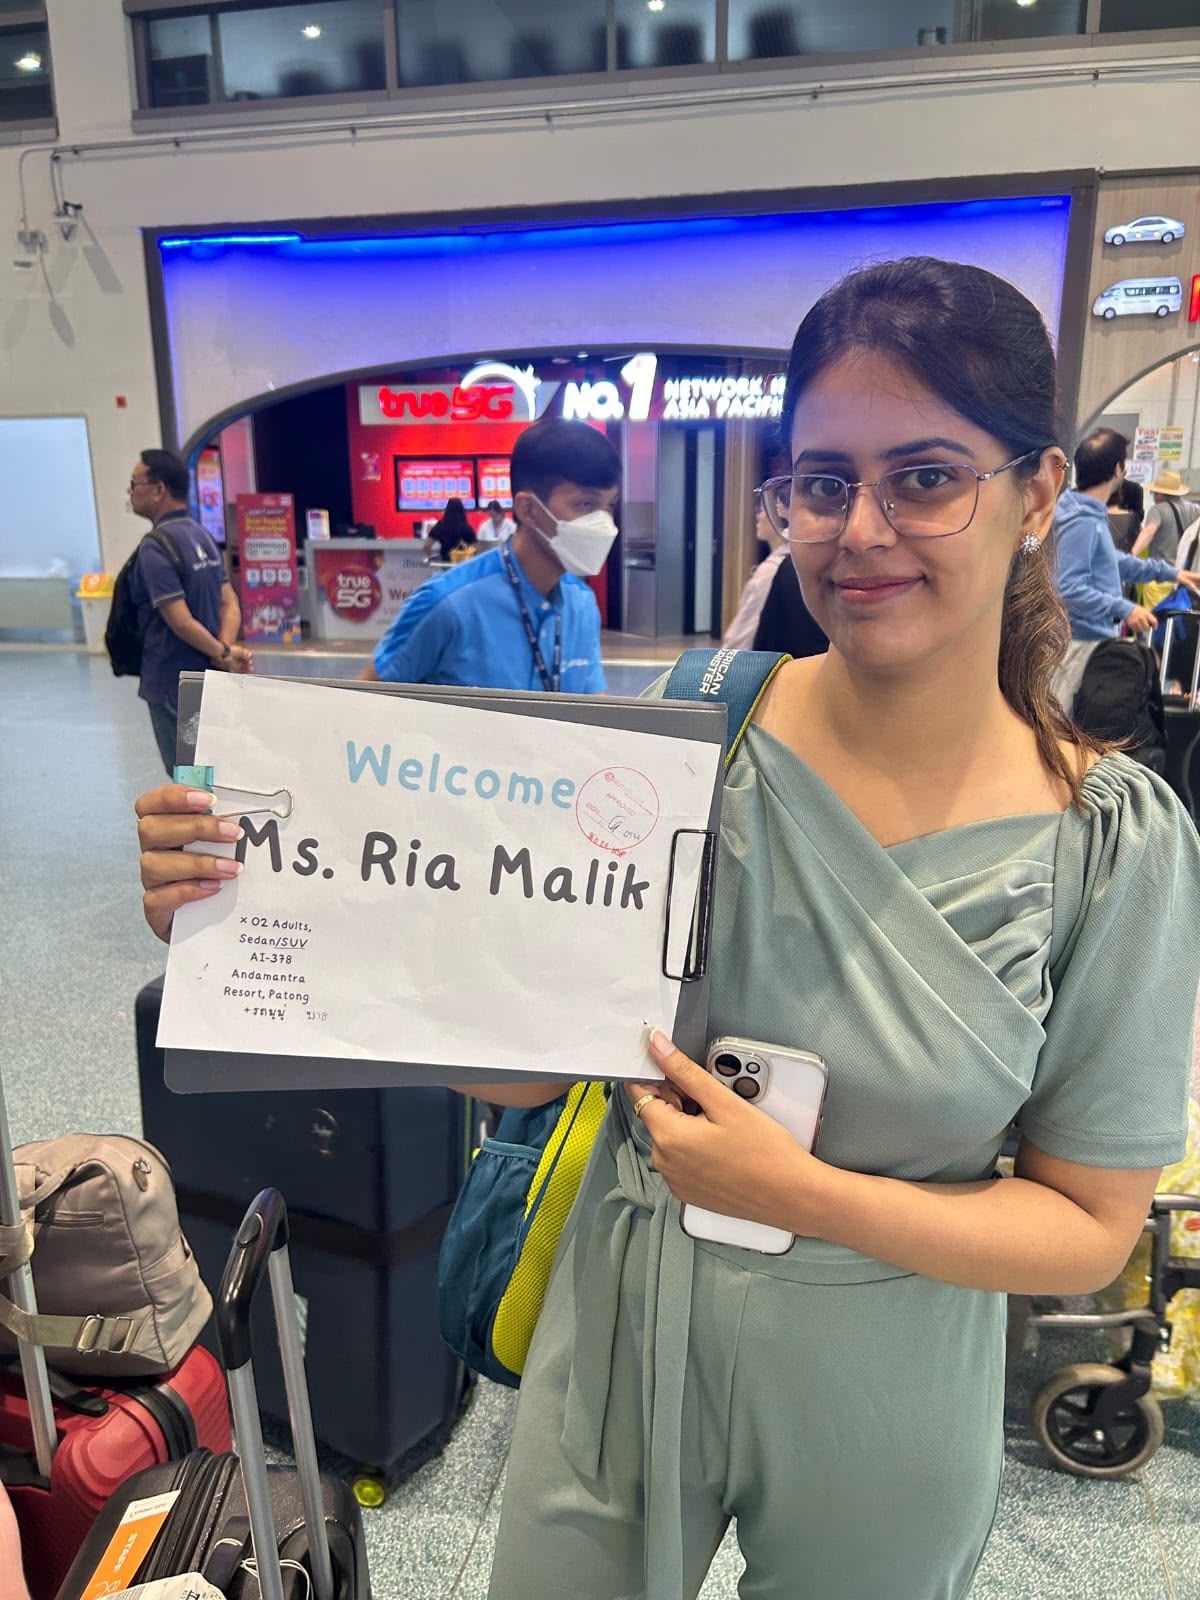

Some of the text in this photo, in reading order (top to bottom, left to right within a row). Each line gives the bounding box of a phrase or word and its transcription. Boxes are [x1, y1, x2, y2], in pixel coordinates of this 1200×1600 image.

[664, 376, 763, 400] NETWORK
[663, 396, 710, 419] ASIA
[337, 574, 371, 588] true
[336, 589, 372, 608] 5G
[346, 740, 576, 809] Welcome
[235, 815, 650, 911] Ms. Ria Malik
[272, 919, 312, 933] Adults,
[239, 933, 308, 948] Sedan/SUV
[250, 952, 292, 964] AI-378
[231, 968, 305, 983] Andamantra
[224, 985, 309, 1005] Resort, Patong
